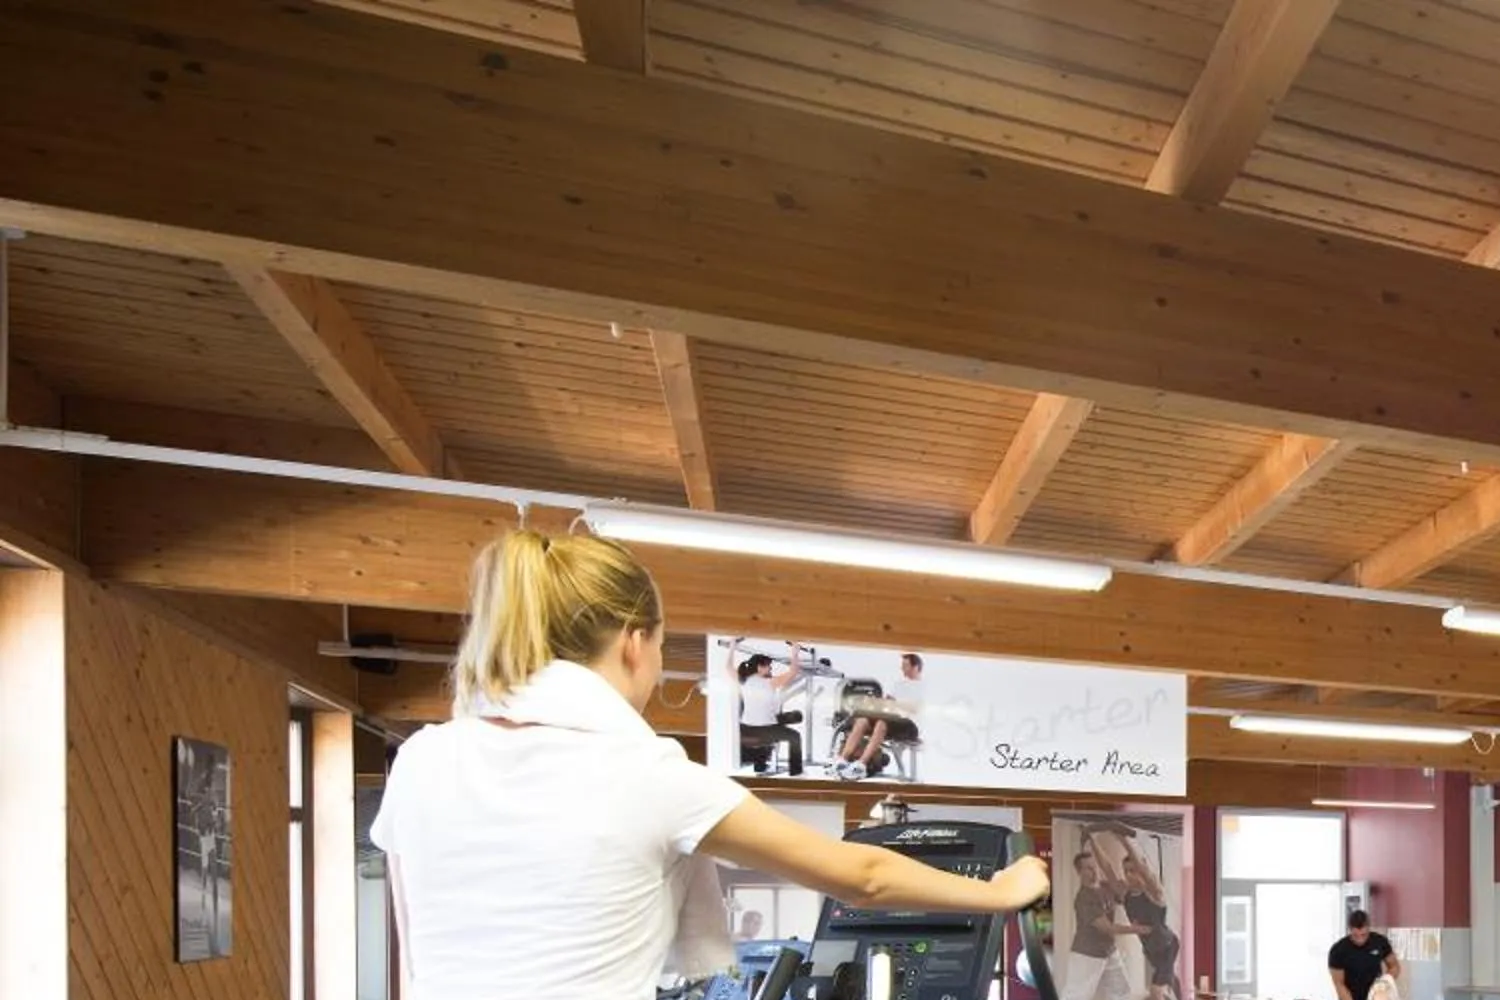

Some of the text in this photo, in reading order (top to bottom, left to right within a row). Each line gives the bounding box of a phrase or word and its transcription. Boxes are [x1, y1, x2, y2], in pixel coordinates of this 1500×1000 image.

[935, 685, 1168, 758] Starter
[990, 743, 1160, 776] Starter Area
